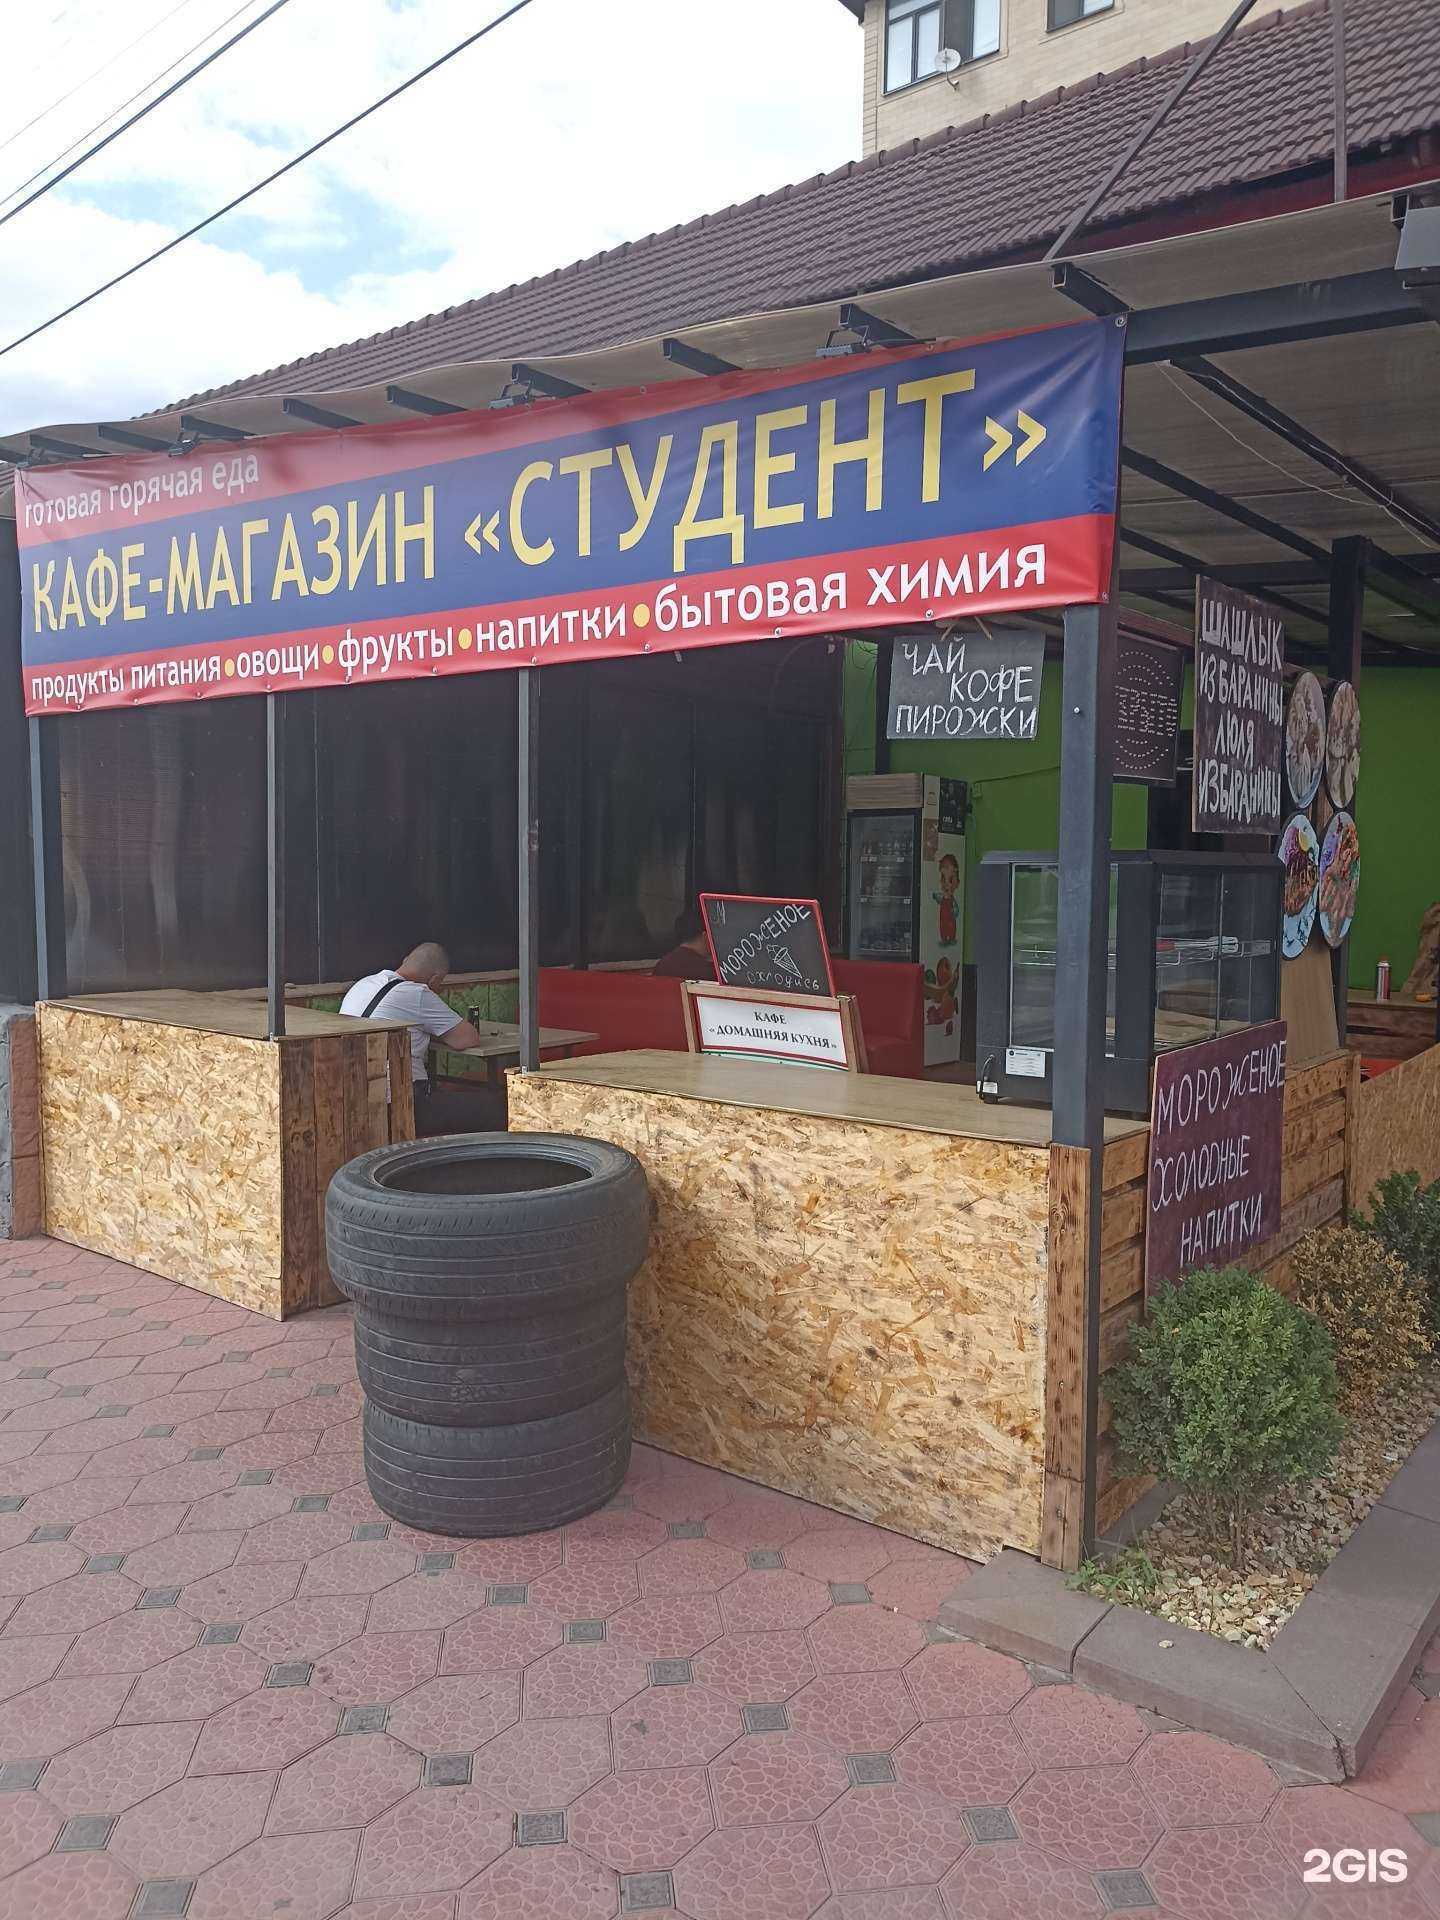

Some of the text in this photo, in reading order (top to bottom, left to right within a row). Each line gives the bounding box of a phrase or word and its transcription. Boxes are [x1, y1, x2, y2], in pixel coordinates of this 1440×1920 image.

[24, 454, 260, 529] готовая горячая еда
[33, 368, 1047, 633] КАФЕ-МАГАЗИН «СТУДЕНТ»
[32, 543, 1046, 703] продукты питания овощи фрукты напитки бытовая химия
[902, 636, 966, 675] ЧАЙ
[1202, 598, 1282, 672] ШАШЛЫК
[896, 704, 1037, 738] ПИРОЖКИ
[949, 664, 1033, 703] КОФЕ
[1214, 709, 1254, 767] ЛЮЛЯ
[719, 903, 811, 983] МОРОЖЕНОЕ
[754, 1011, 786, 1024] КАФЕ
[1157, 1039, 1286, 1135] МОРОЖЕНОЕ
[1151, 1134, 1251, 1211] ХОЛОДНЫЕ
[1180, 1192, 1262, 1267] НАПИТКИ
